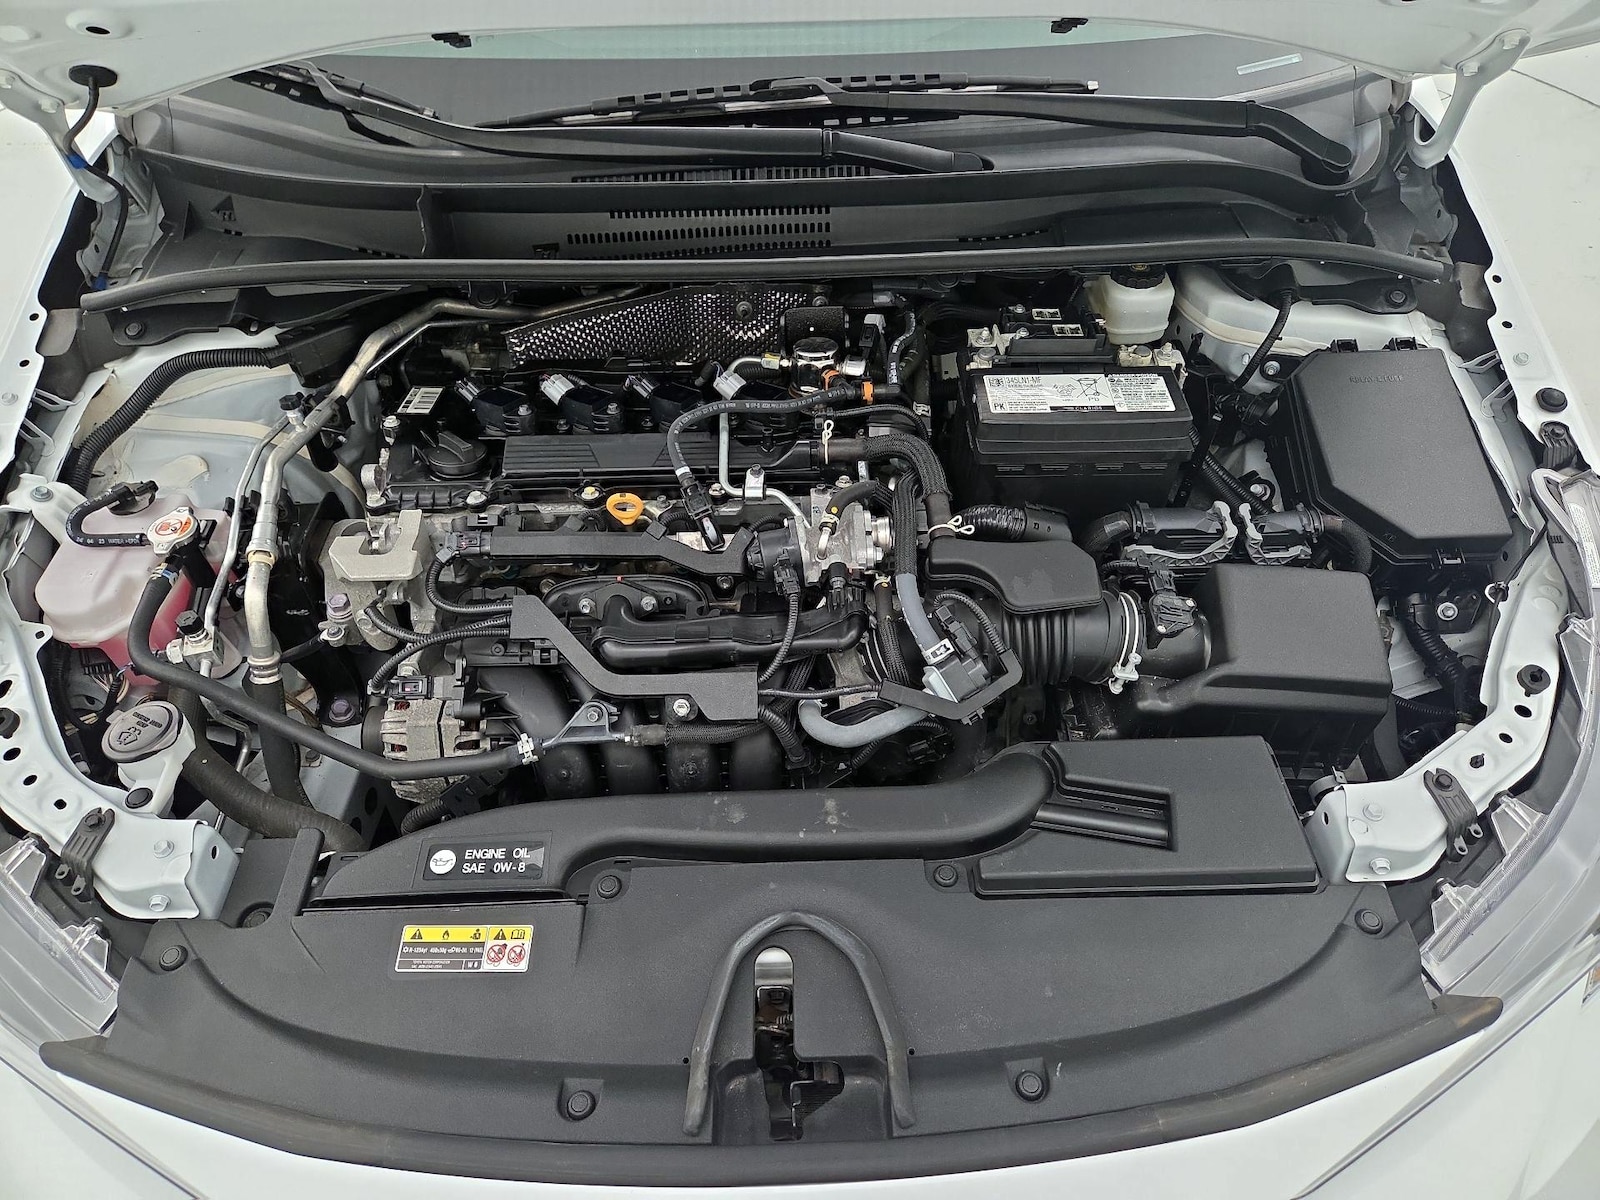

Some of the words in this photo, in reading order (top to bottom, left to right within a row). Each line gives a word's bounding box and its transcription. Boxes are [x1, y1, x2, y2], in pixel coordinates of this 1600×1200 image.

[993, 402, 1006, 411] PK
[464, 848, 506, 859] ENGINE
[513, 847, 530, 858] OIL
[462, 862, 486, 873] SAE
[493, 862, 526, 873] 0W-8
